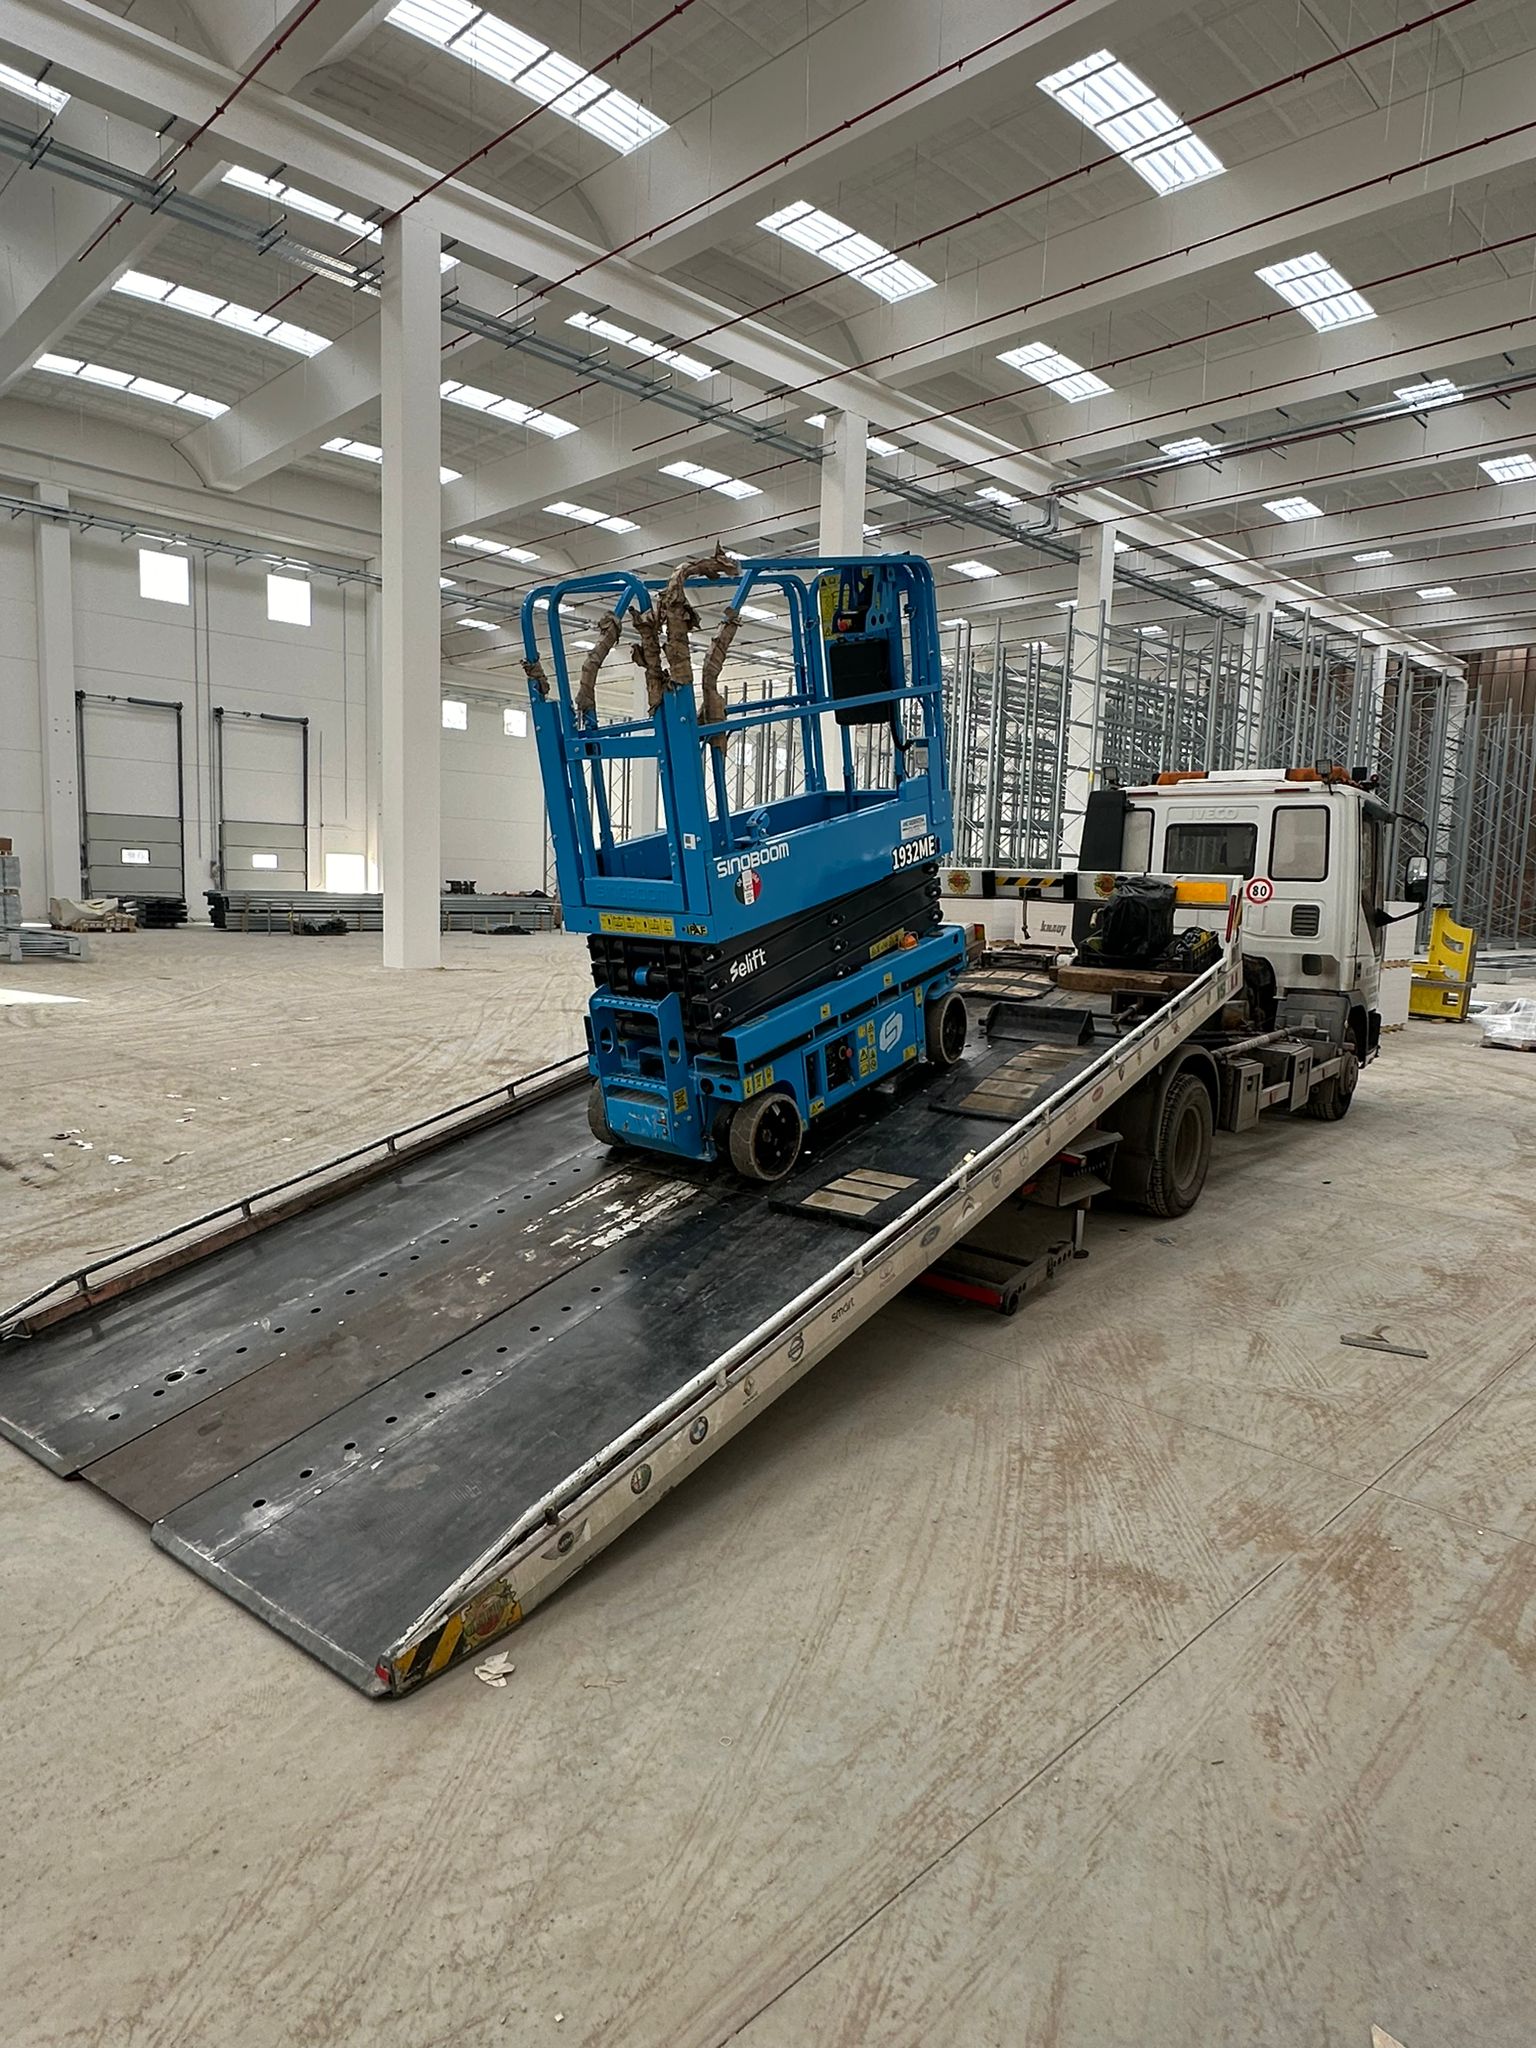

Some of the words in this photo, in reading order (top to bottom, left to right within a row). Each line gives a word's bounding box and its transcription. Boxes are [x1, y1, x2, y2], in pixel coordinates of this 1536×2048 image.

[1188, 807, 1239, 821] IVECO
[714, 842, 790, 879] SINOBOOM
[892, 834, 936, 870] 1932ME
[1252, 885, 1268, 897] 80
[730, 948, 767, 983] Selift
[831, 1297, 855, 1322] smart
